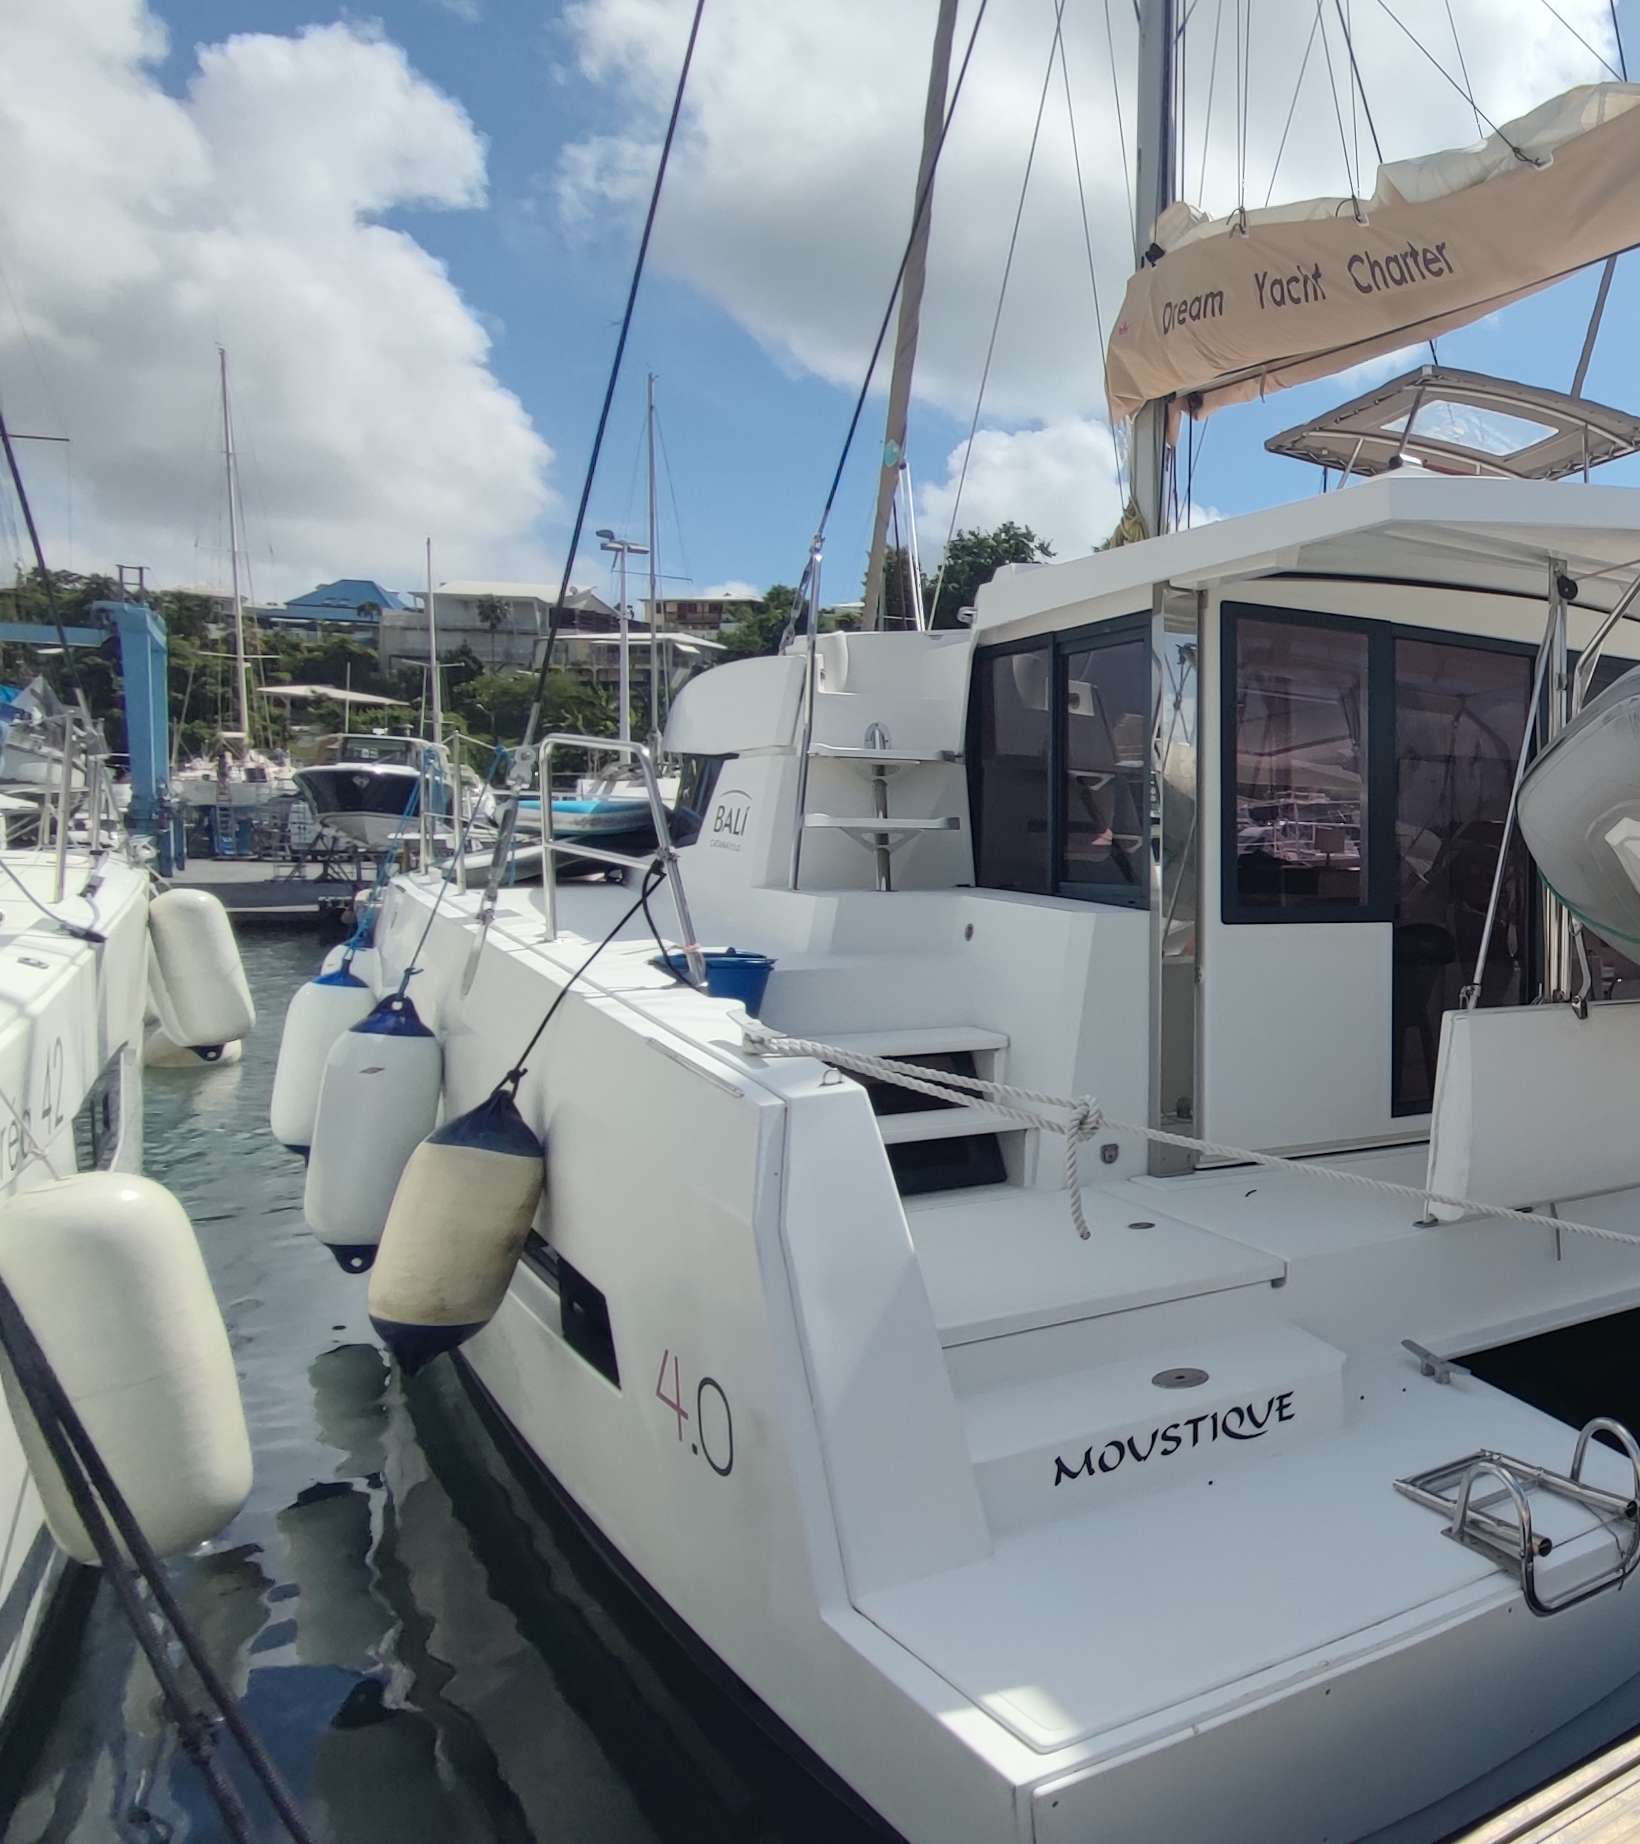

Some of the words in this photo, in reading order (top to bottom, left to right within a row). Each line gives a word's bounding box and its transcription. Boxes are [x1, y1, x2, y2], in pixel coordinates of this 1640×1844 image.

[1163, 290, 1224, 335] Dream
[1254, 263, 1327, 309] Yacht
[1347, 241, 1454, 294] Charter
[656, 1349, 734, 1477] 4.0
[1054, 1391, 1296, 1486] MOUSTIQUE
